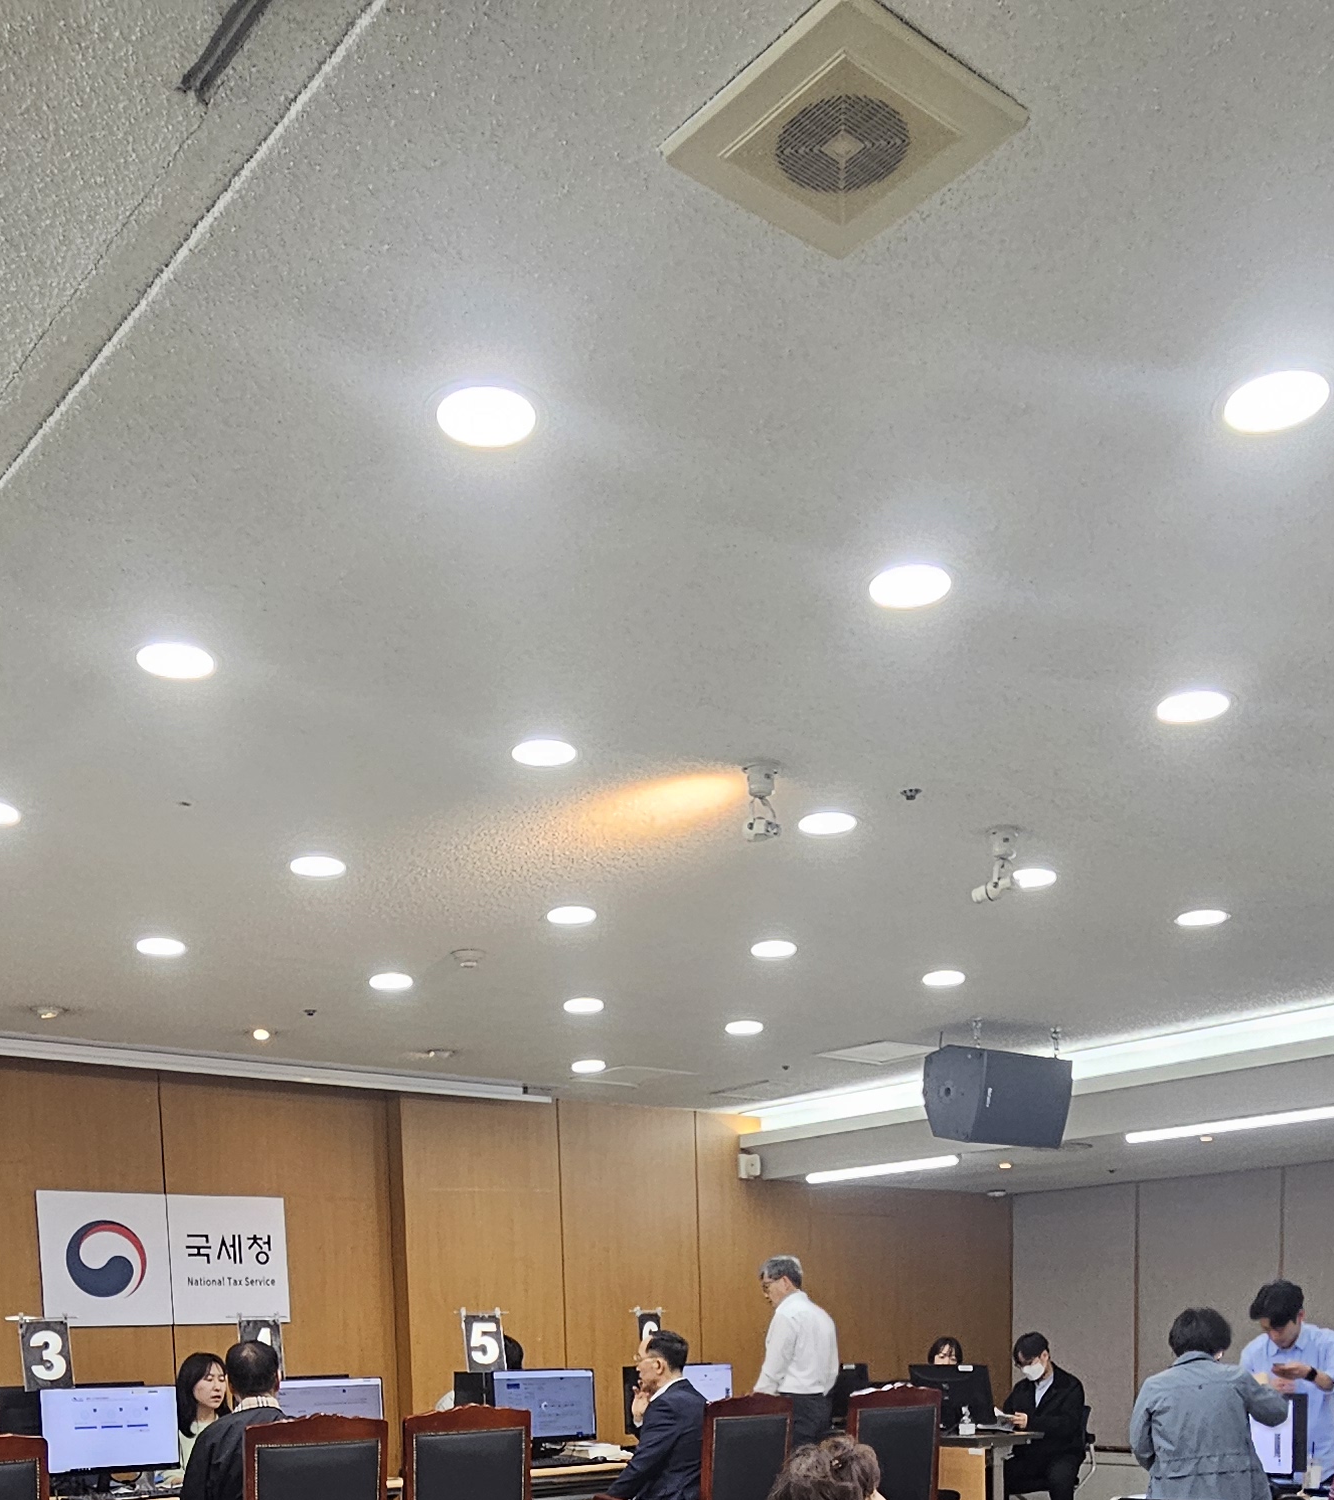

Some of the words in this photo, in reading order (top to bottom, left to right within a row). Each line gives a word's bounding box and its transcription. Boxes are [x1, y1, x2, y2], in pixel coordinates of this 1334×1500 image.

[185, 1234, 272, 1266] 국세청
[187, 1276, 225, 1287] National
[227, 1276, 243, 1287] Tax
[244, 1276, 276, 1287] Service
[30, 1329, 67, 1381] 3
[470, 1322, 499, 1365] 5
